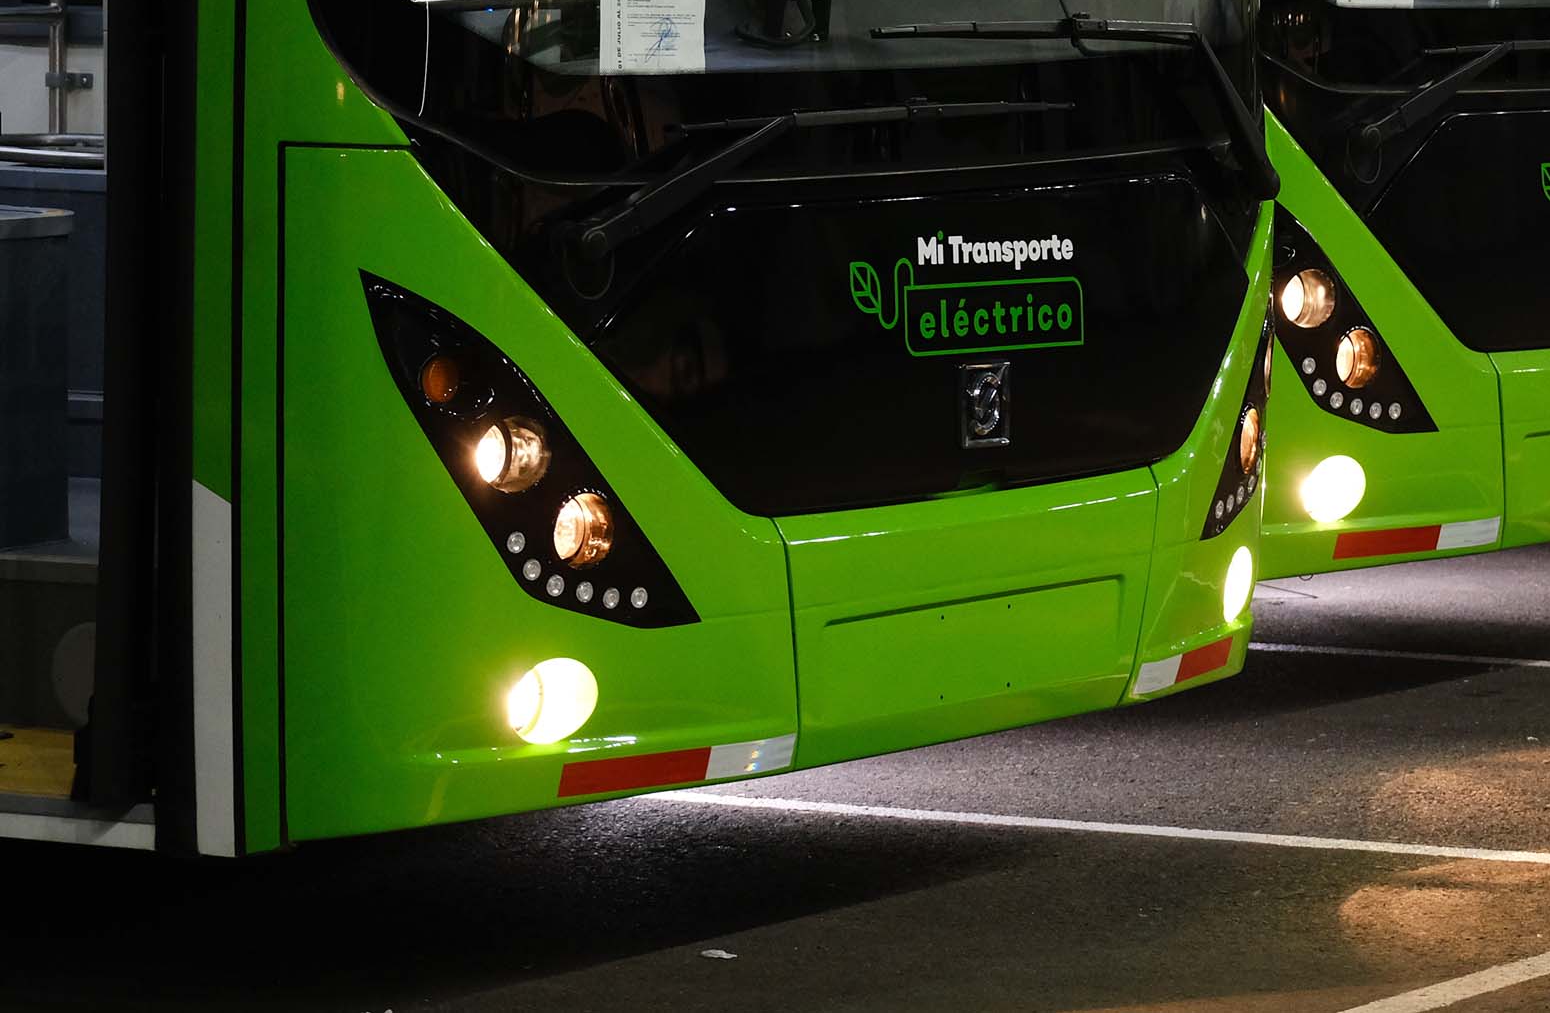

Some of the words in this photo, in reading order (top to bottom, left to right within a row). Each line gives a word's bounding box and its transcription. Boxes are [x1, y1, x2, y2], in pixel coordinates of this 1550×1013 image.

[917, 230, 944, 265] Mi
[948, 235, 1074, 270] Transporte
[919, 293, 1073, 339] eléctrico
